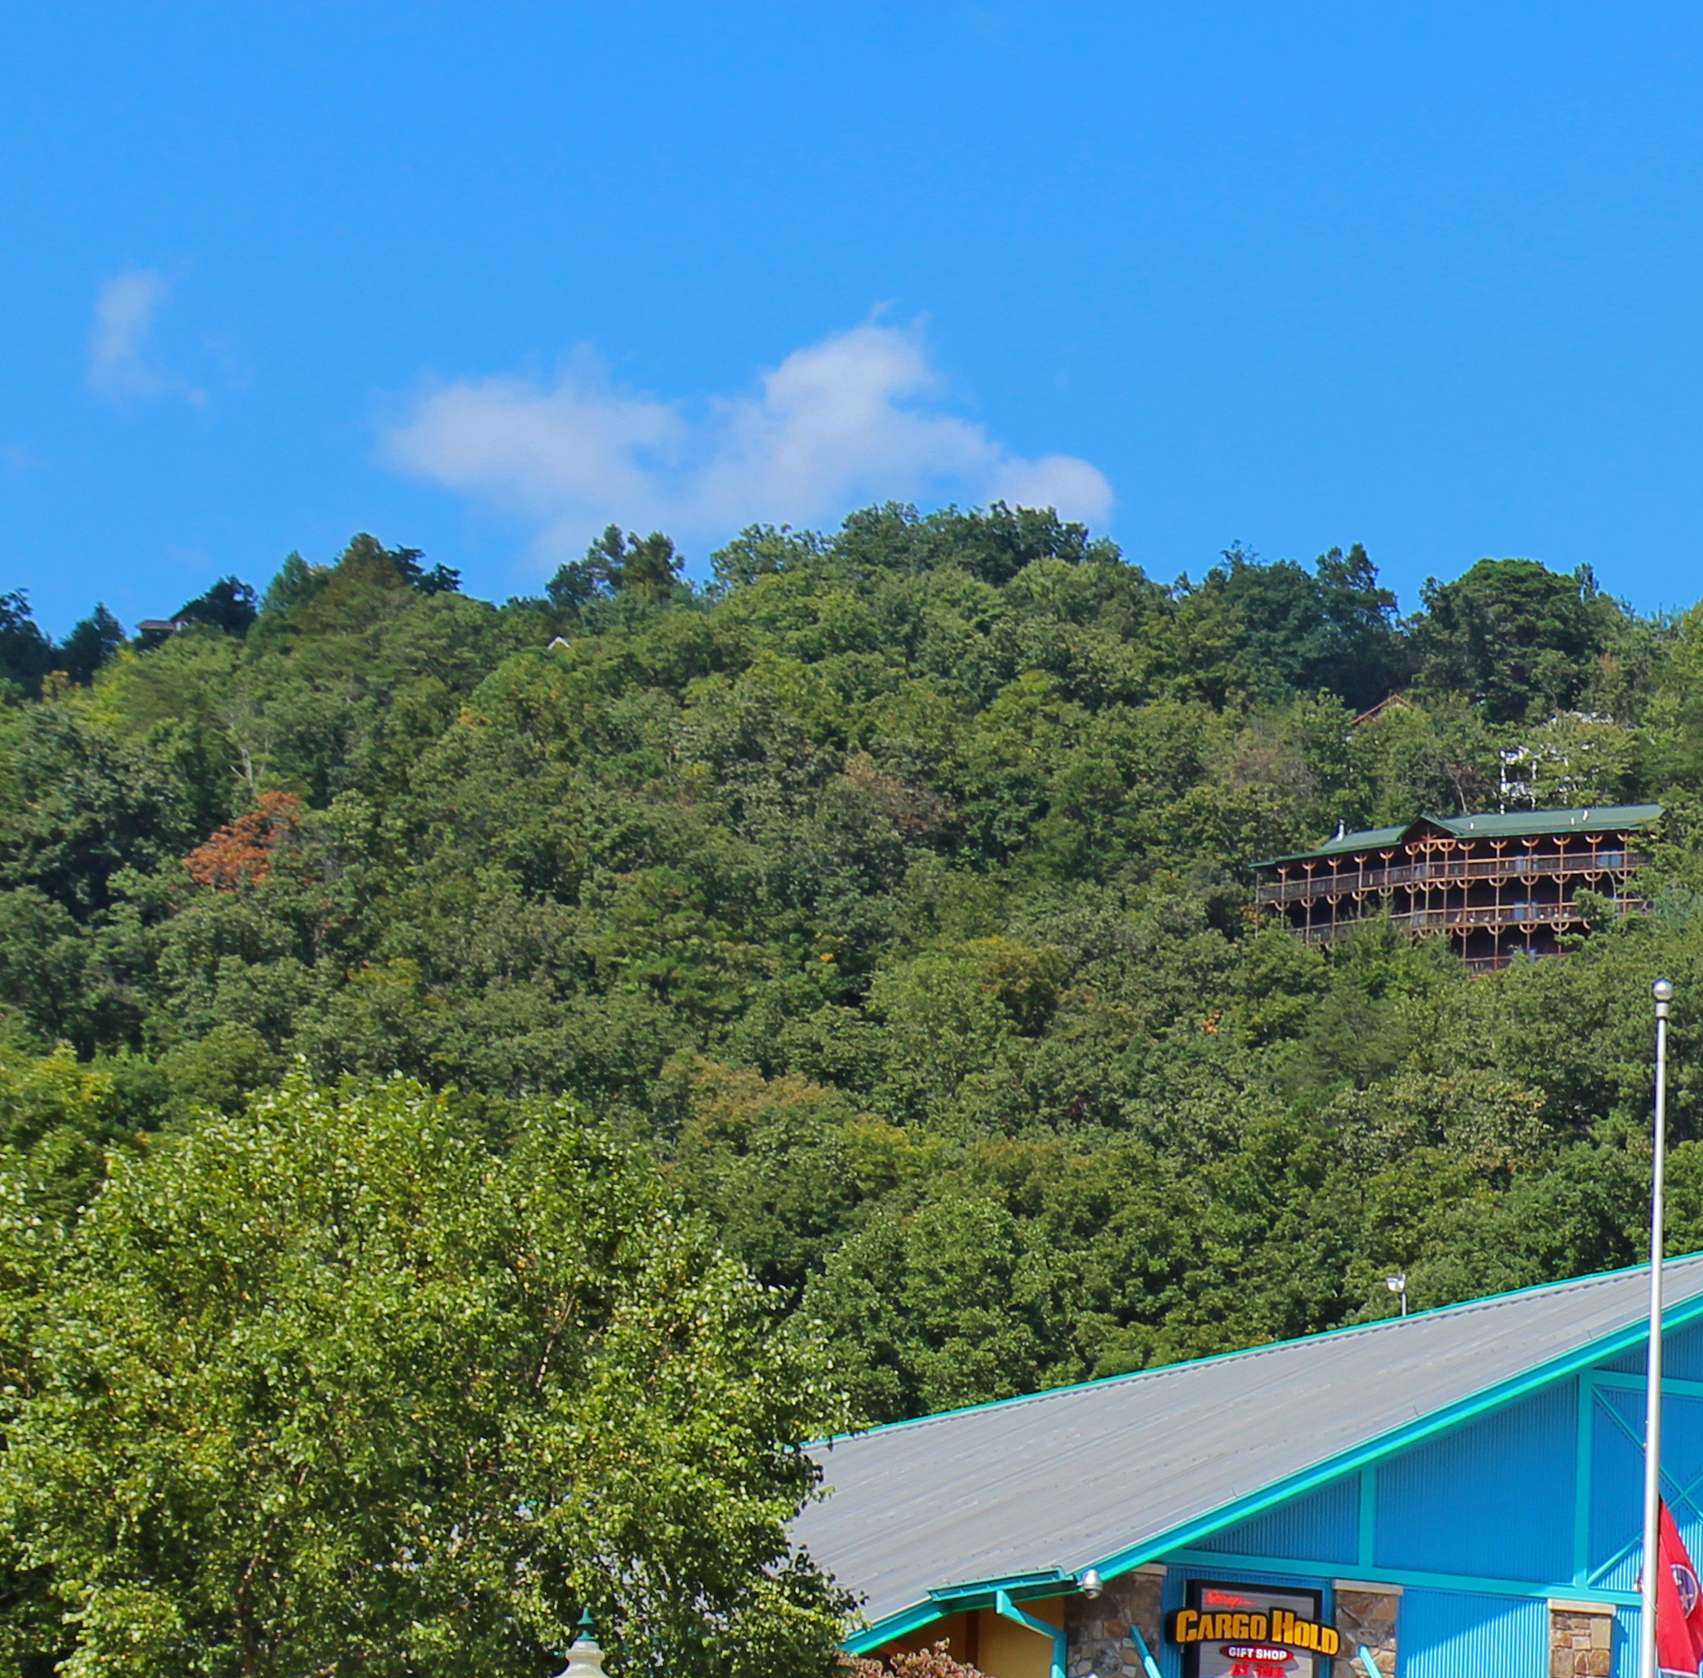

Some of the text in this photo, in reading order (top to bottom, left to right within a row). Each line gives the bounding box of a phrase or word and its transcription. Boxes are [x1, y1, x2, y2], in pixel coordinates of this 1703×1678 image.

[1176, 1609, 1340, 1656] CARGO HOLD
[1228, 1647, 1287, 1661] GIFT SHOP
